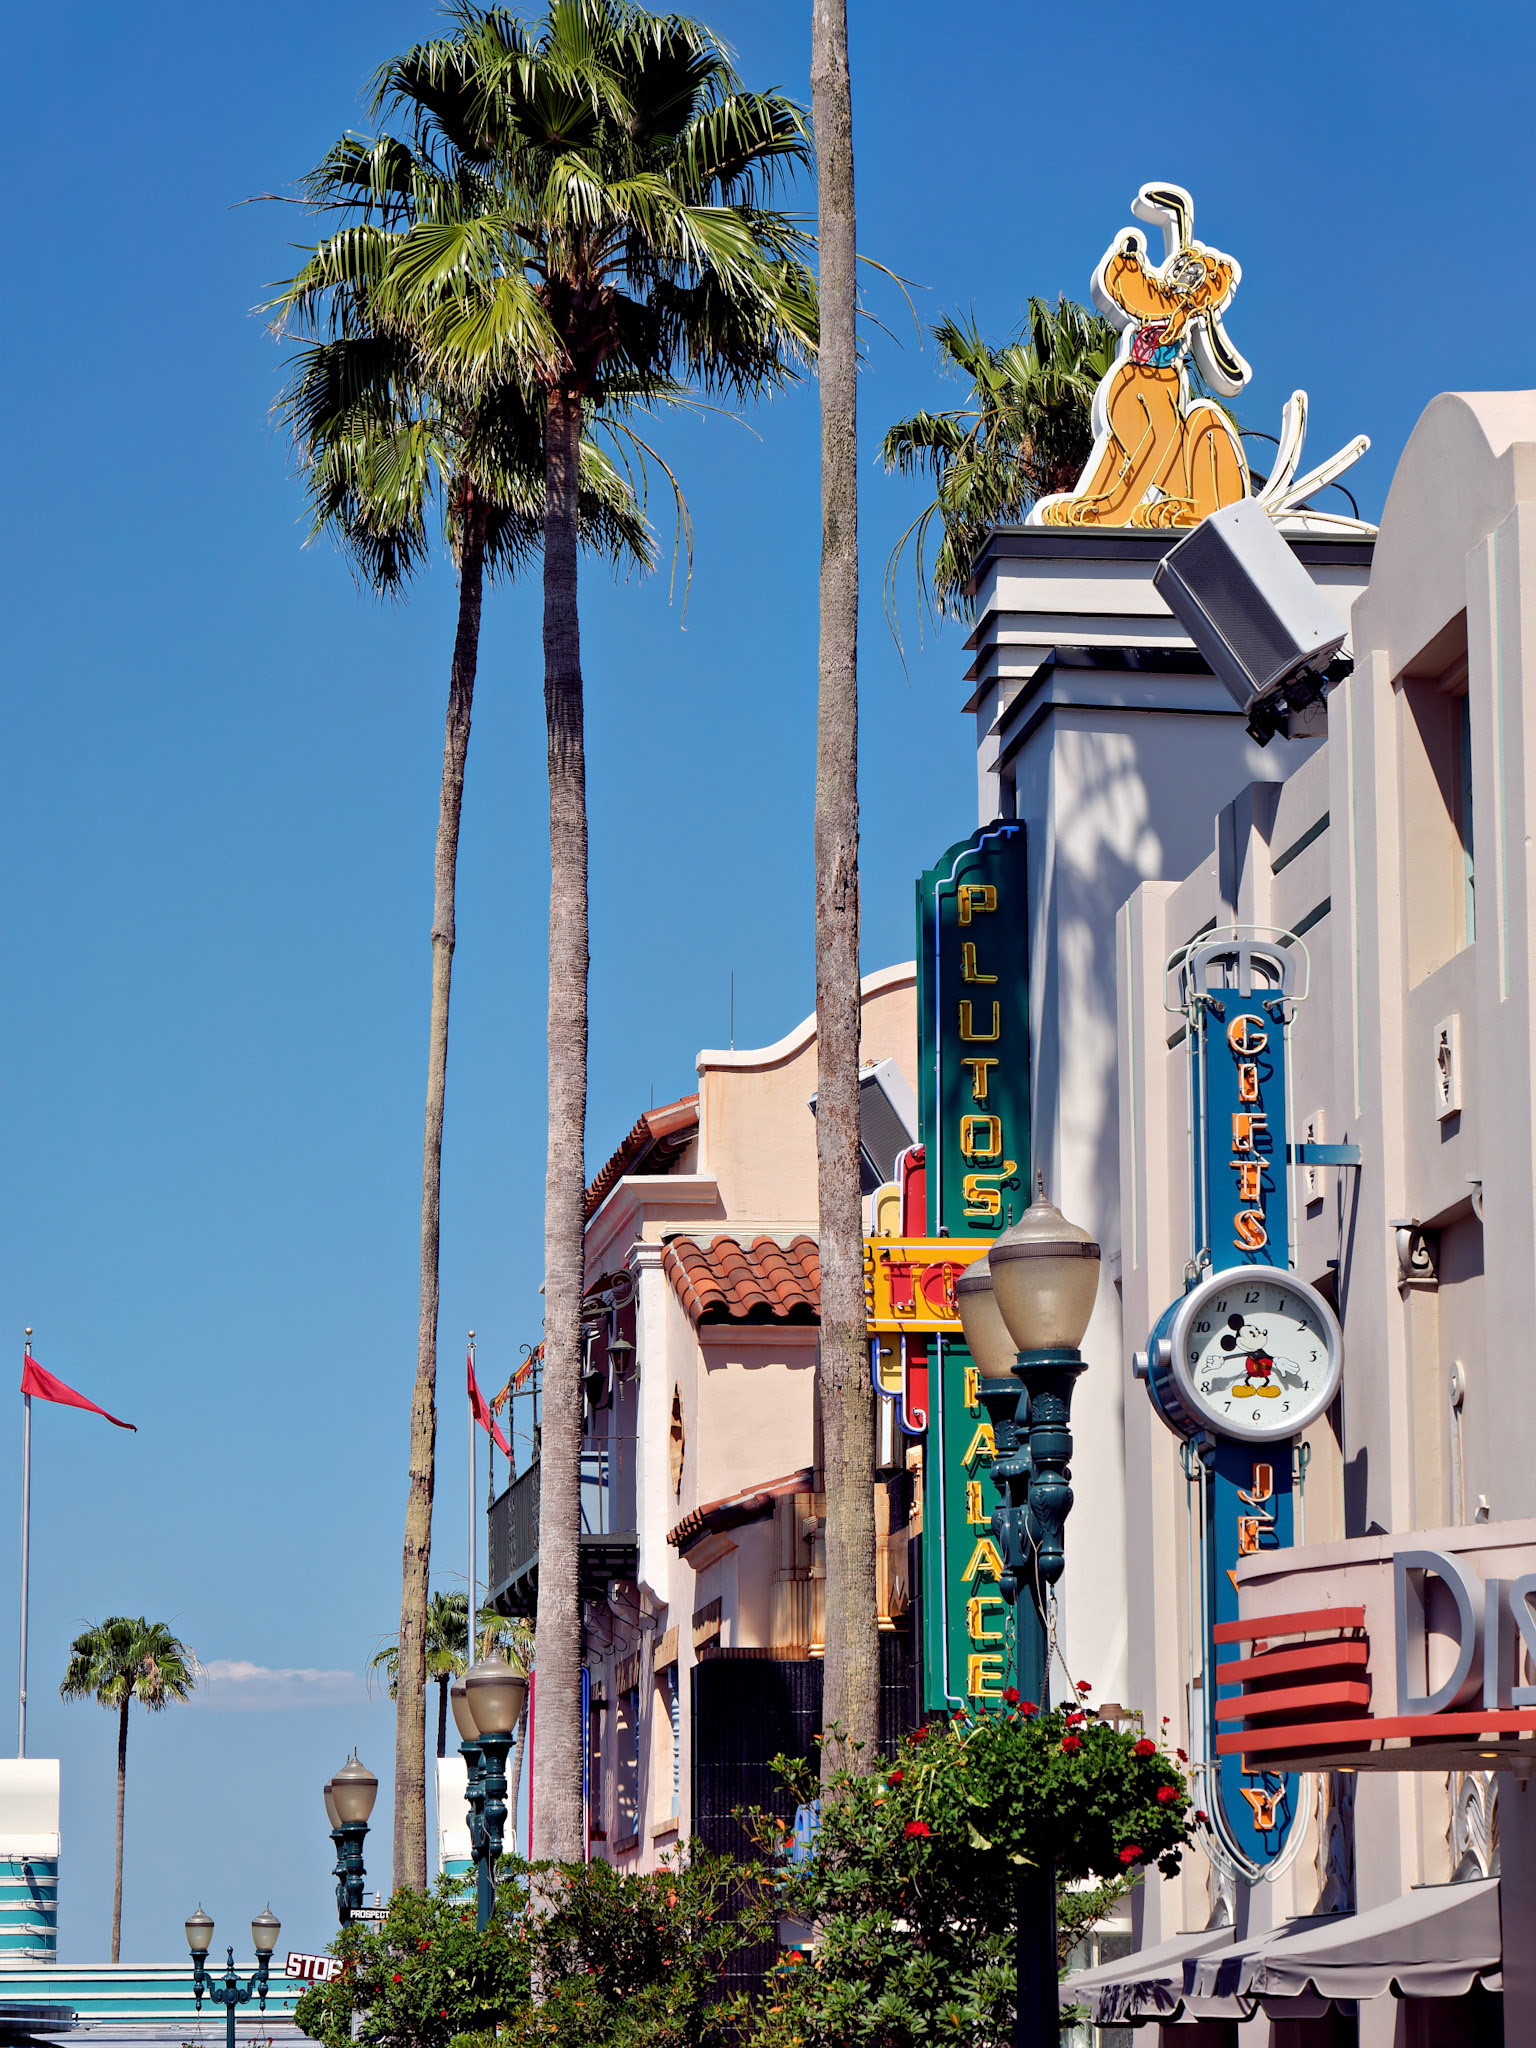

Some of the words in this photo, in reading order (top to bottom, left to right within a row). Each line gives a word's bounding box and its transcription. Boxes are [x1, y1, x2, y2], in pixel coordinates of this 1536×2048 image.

[957, 884, 1018, 1216] PLUTO'S
[1227, 1014, 1269, 1250] GIFTS
[880, 1260, 968, 1307] TO
[1244, 1291, 1260, 1304] 12
[1215, 1301, 1228, 1313] 11
[1277, 1300, 1284, 1312] 1
[1197, 1321, 1211, 1333] 10
[1296, 1319, 1308, 1332] 2
[1190, 1351, 1200, 1364] 9
[1308, 1350, 1317, 1362] 3
[1200, 1381, 1210, 1393] 8
[1302, 1380, 1309, 1392] 4
[1223, 1401, 1231, 1413] 7
[1280, 1401, 1290, 1413] 5
[1252, 1409, 1261, 1421] 6
[350, 1910, 389, 1918] PROSPECT
[286, 1953, 344, 1982] STOP
